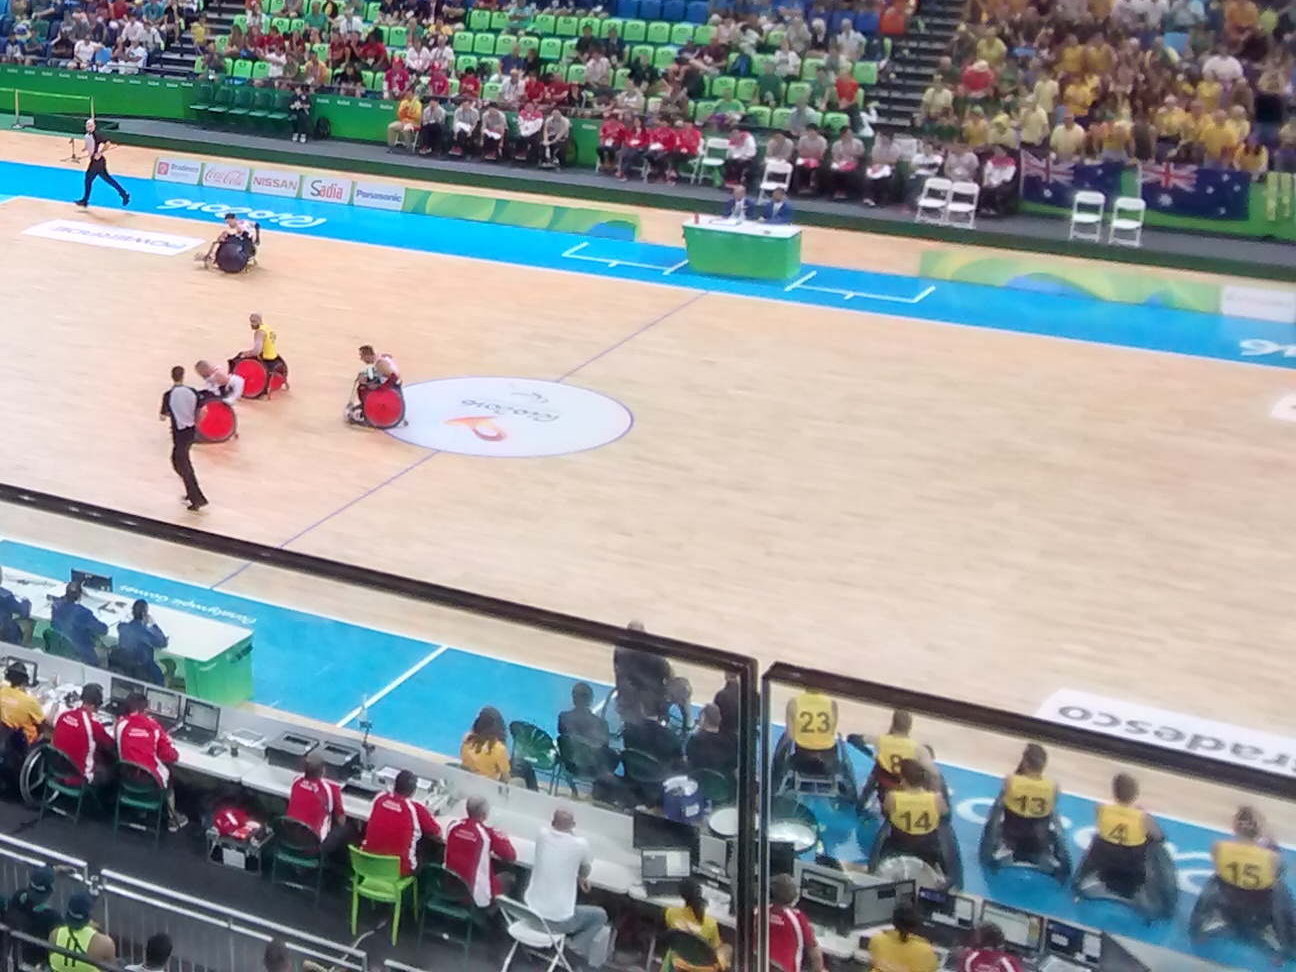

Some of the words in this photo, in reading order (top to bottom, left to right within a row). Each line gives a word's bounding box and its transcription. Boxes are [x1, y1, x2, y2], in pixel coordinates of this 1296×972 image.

[171, 162, 199, 173] Bradesco
[253, 176, 298, 191] NISSAN
[310, 179, 344, 200] Sadia
[356, 189, 402, 203] Panasonic
[157, 198, 327, 228] Rio2016
[799, 711, 831, 734] 23
[1015, 795, 1048, 816] 13
[900, 810, 932, 831] 14
[1108, 823, 1129, 844] 4
[1227, 861, 1261, 886] 15
